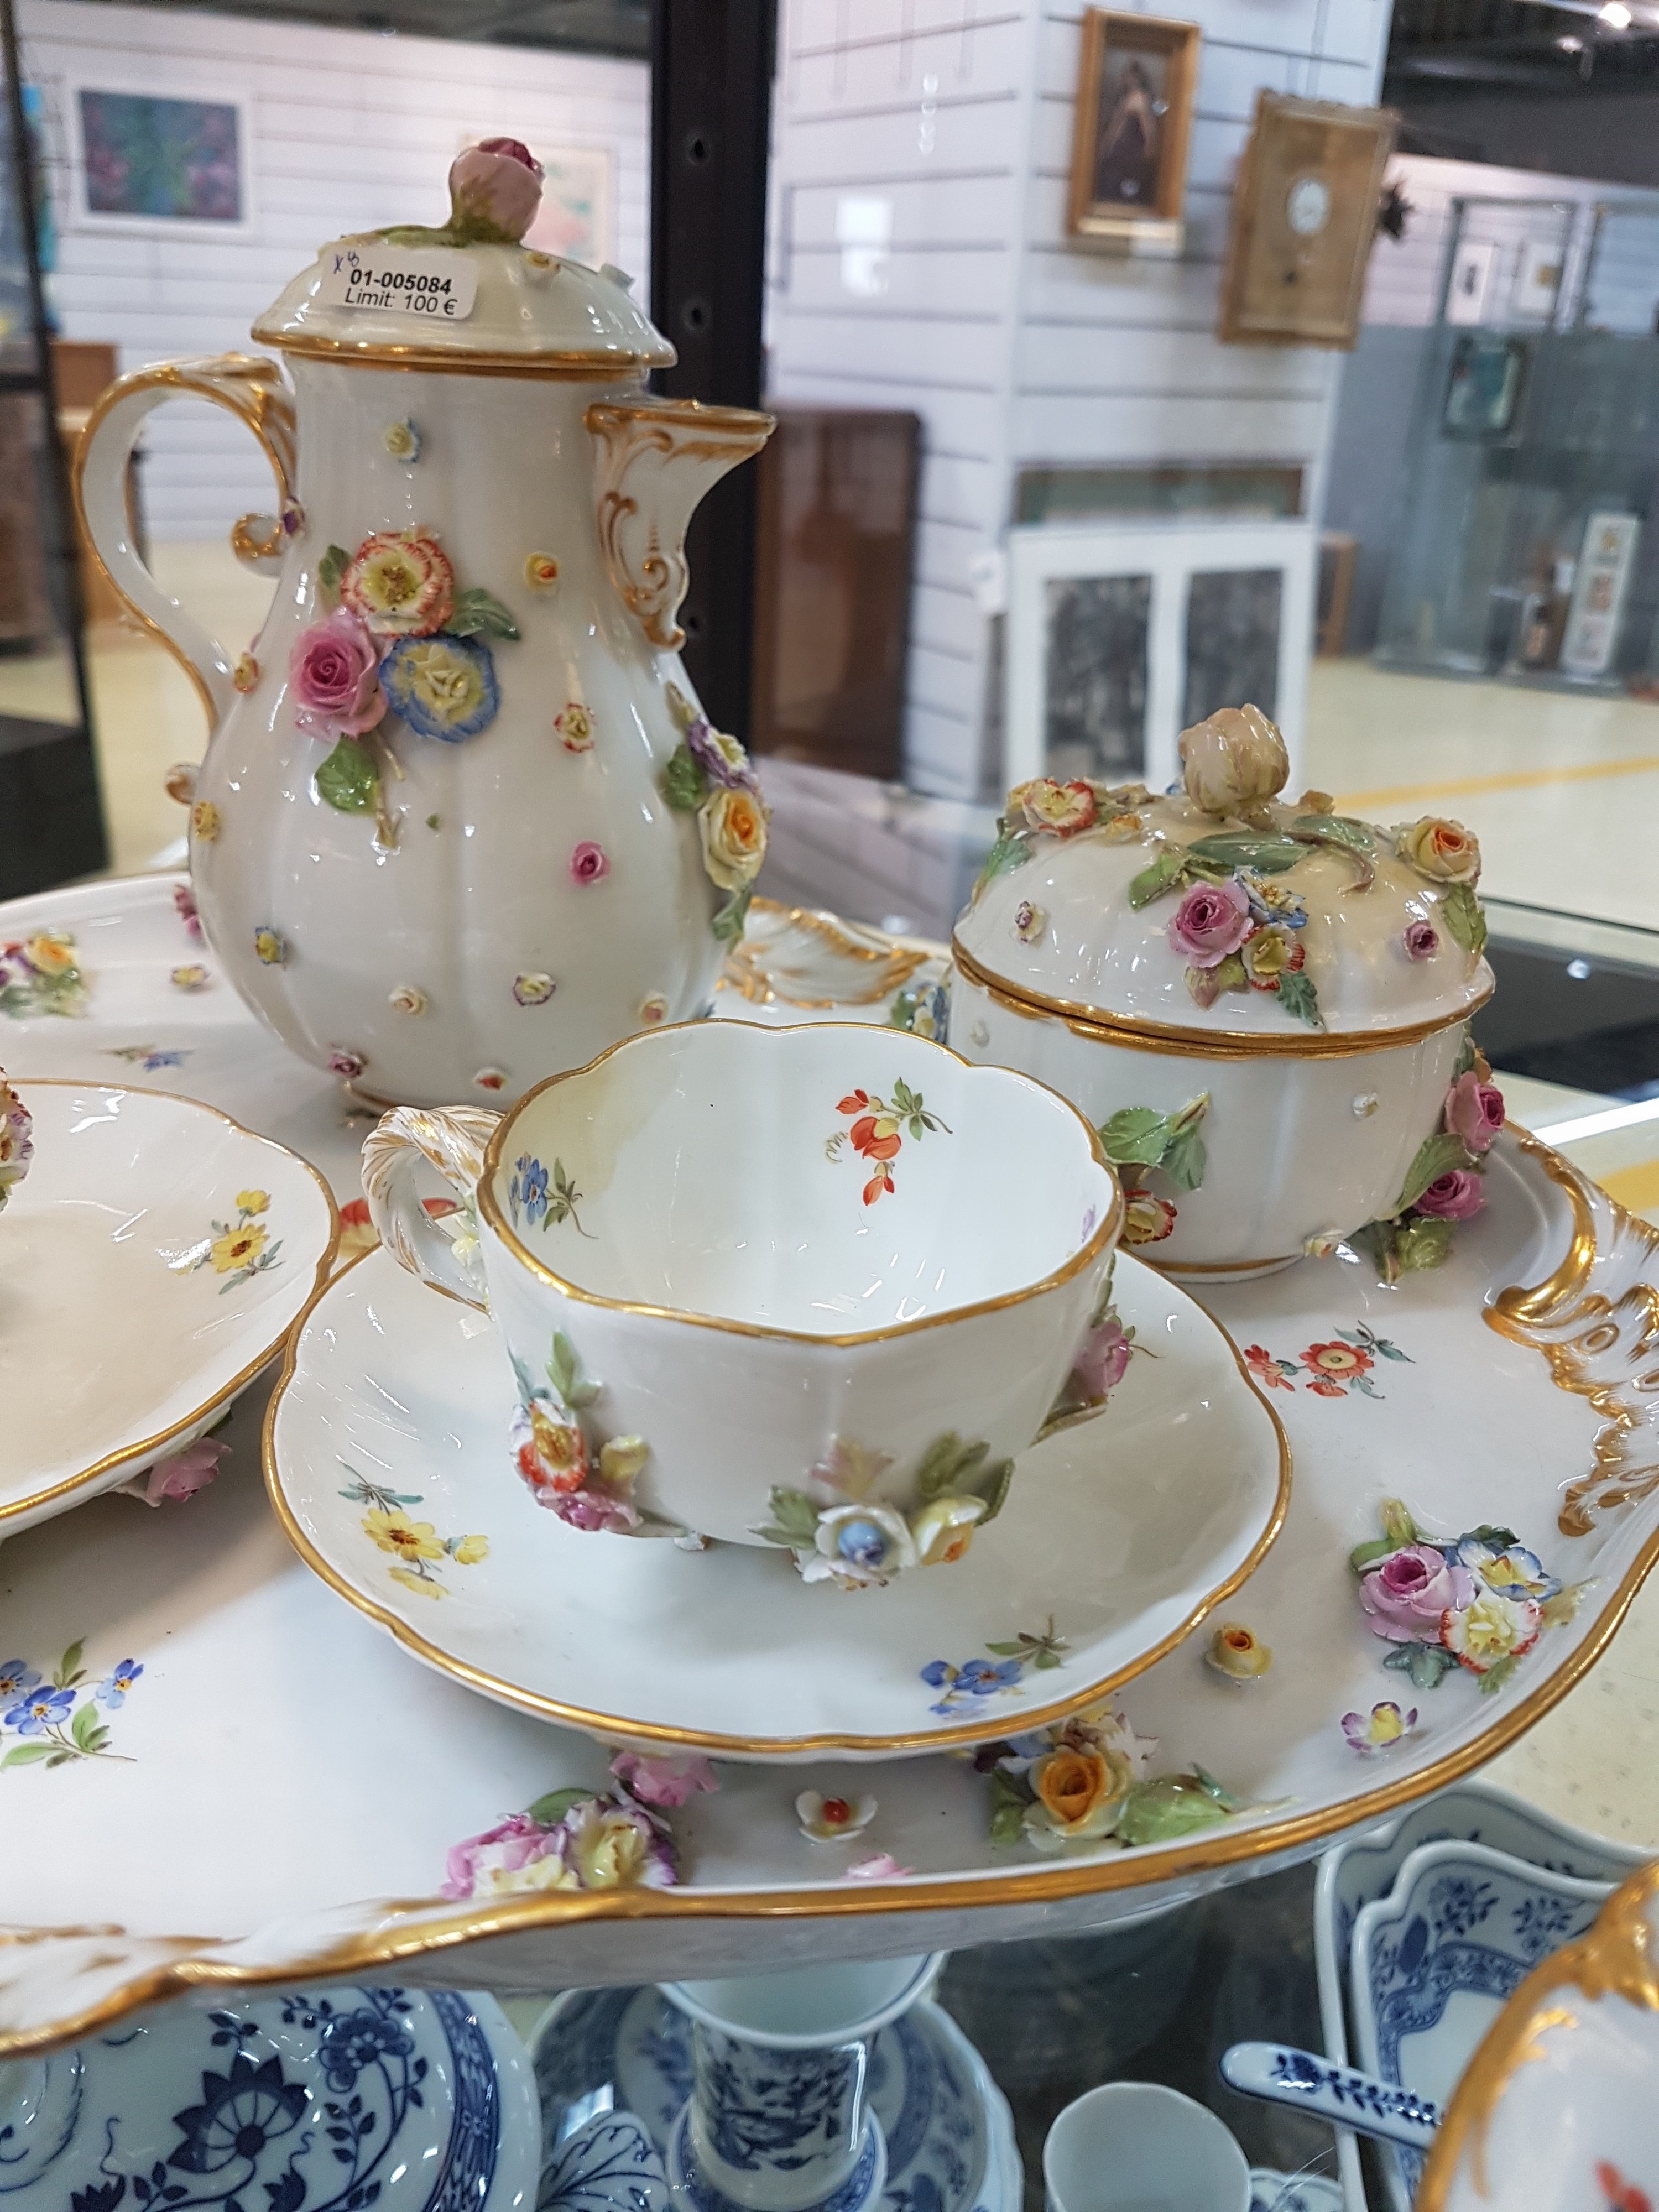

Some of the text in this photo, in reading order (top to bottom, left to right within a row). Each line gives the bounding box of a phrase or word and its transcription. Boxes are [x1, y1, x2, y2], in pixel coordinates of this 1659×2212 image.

[350, 269, 452, 294] 01-005084
[345, 288, 394, 308] Limit:
[404, 294, 439, 313] 100
